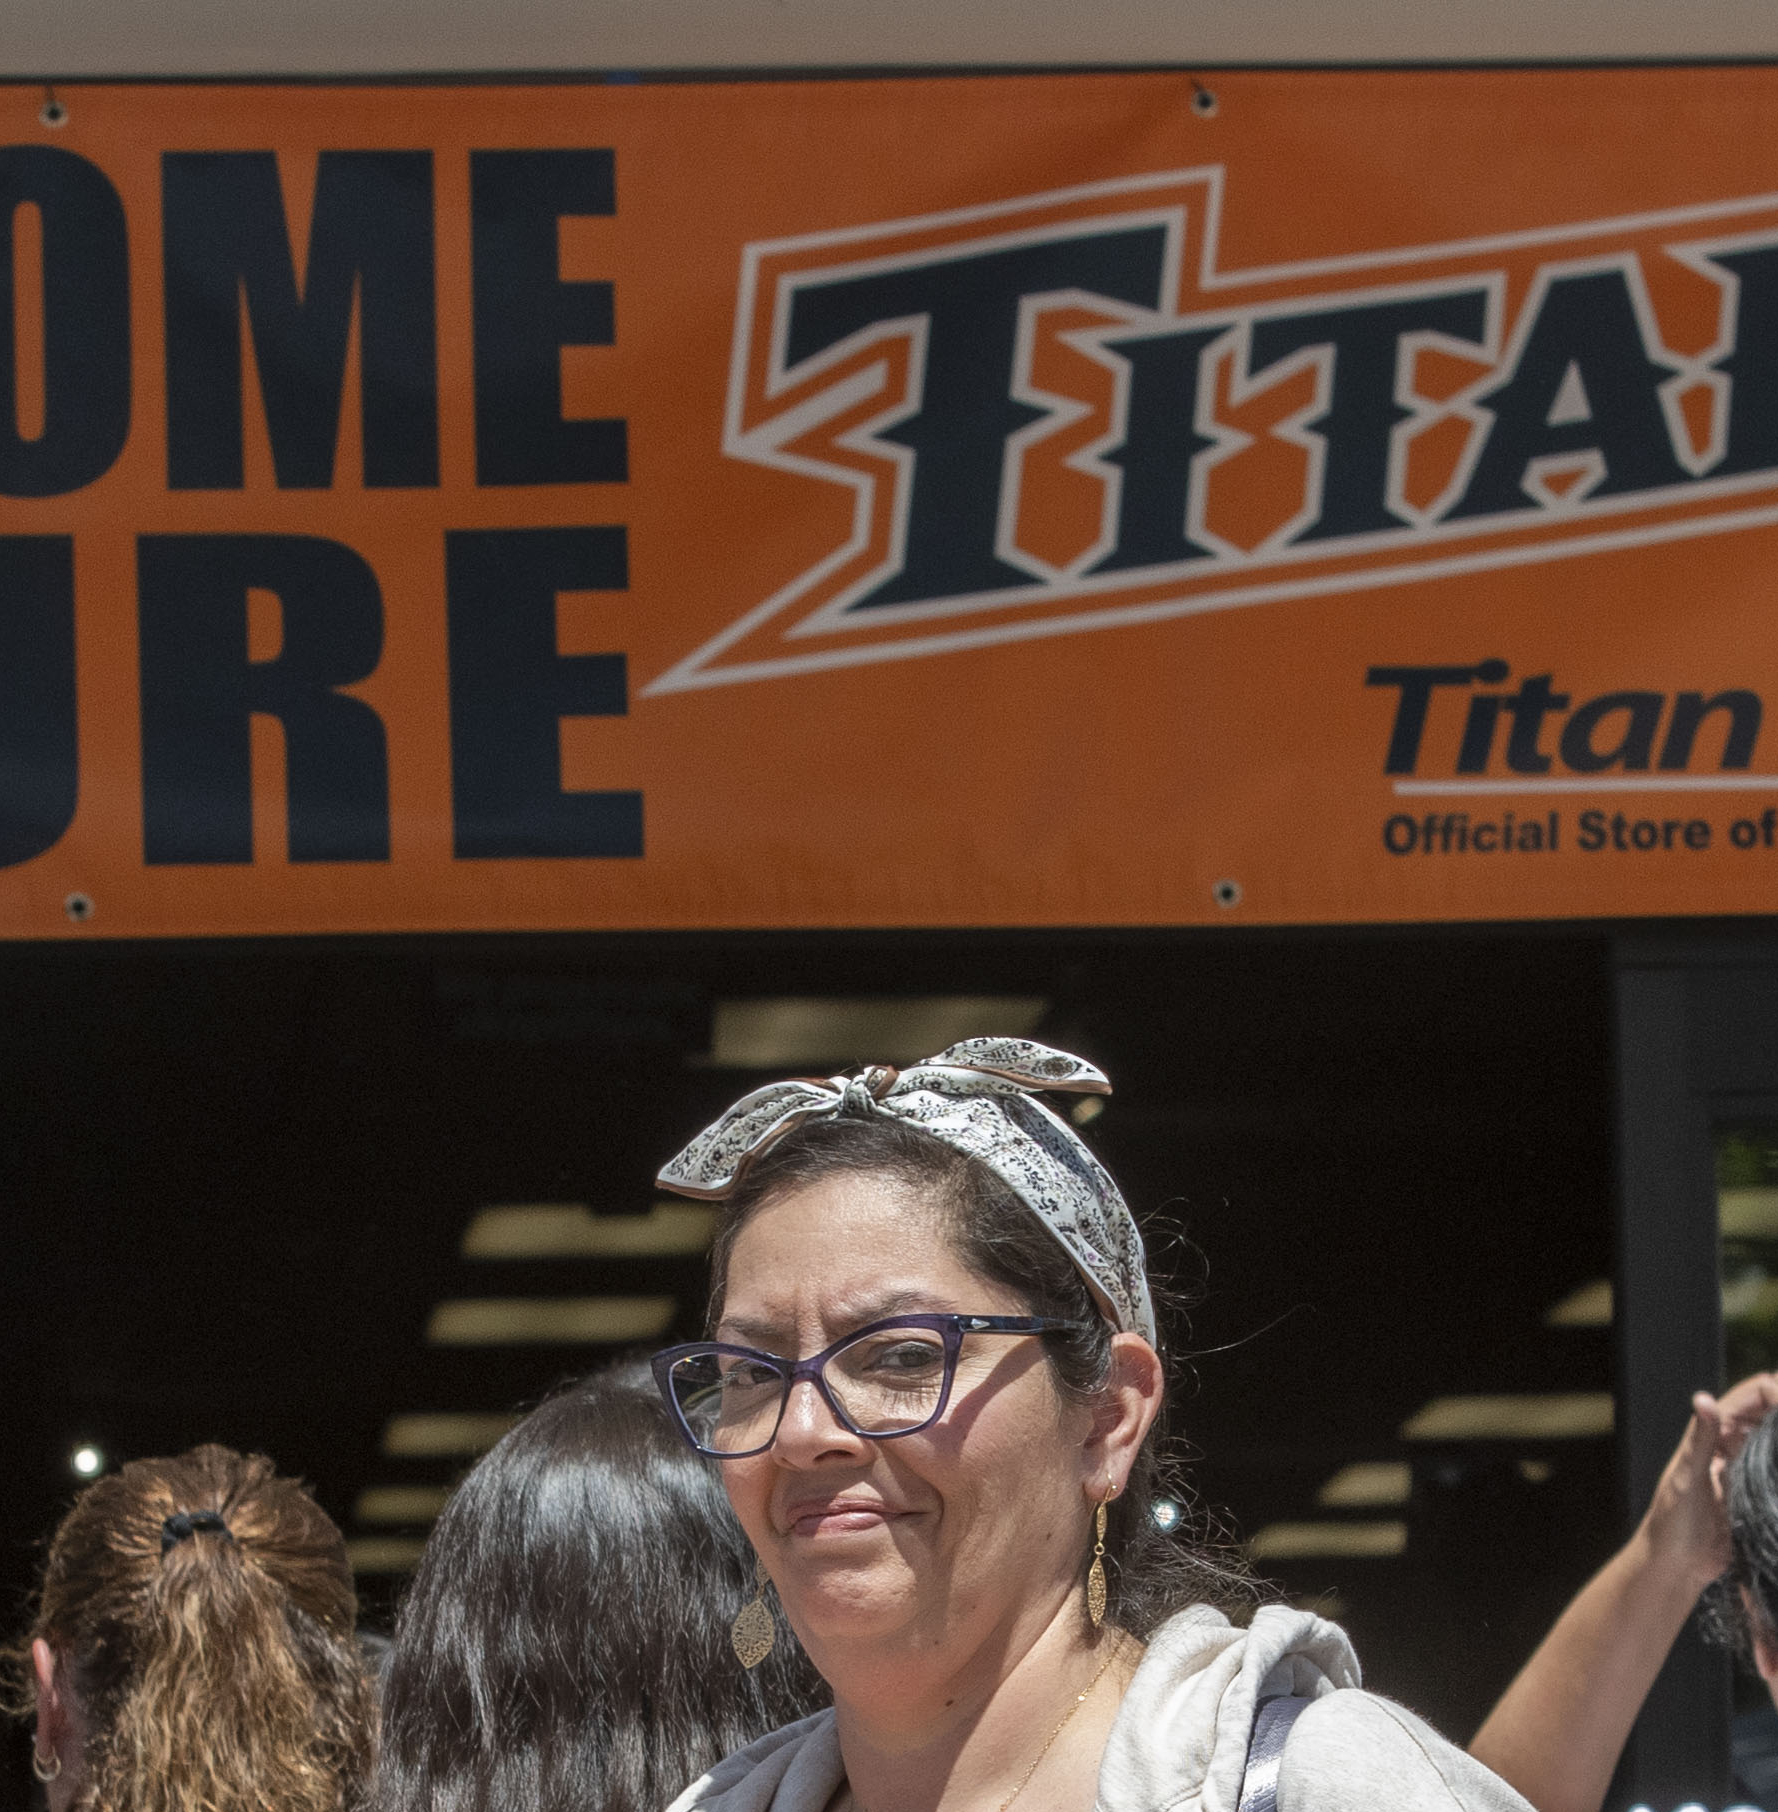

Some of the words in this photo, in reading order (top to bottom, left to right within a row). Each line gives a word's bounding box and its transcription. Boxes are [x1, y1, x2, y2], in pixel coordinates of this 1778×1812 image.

[1365, 658, 1763, 776] Titan
[1382, 811, 1560, 856] Official
[1577, 810, 1713, 852] Store
[1729, 808, 1778, 849] of
